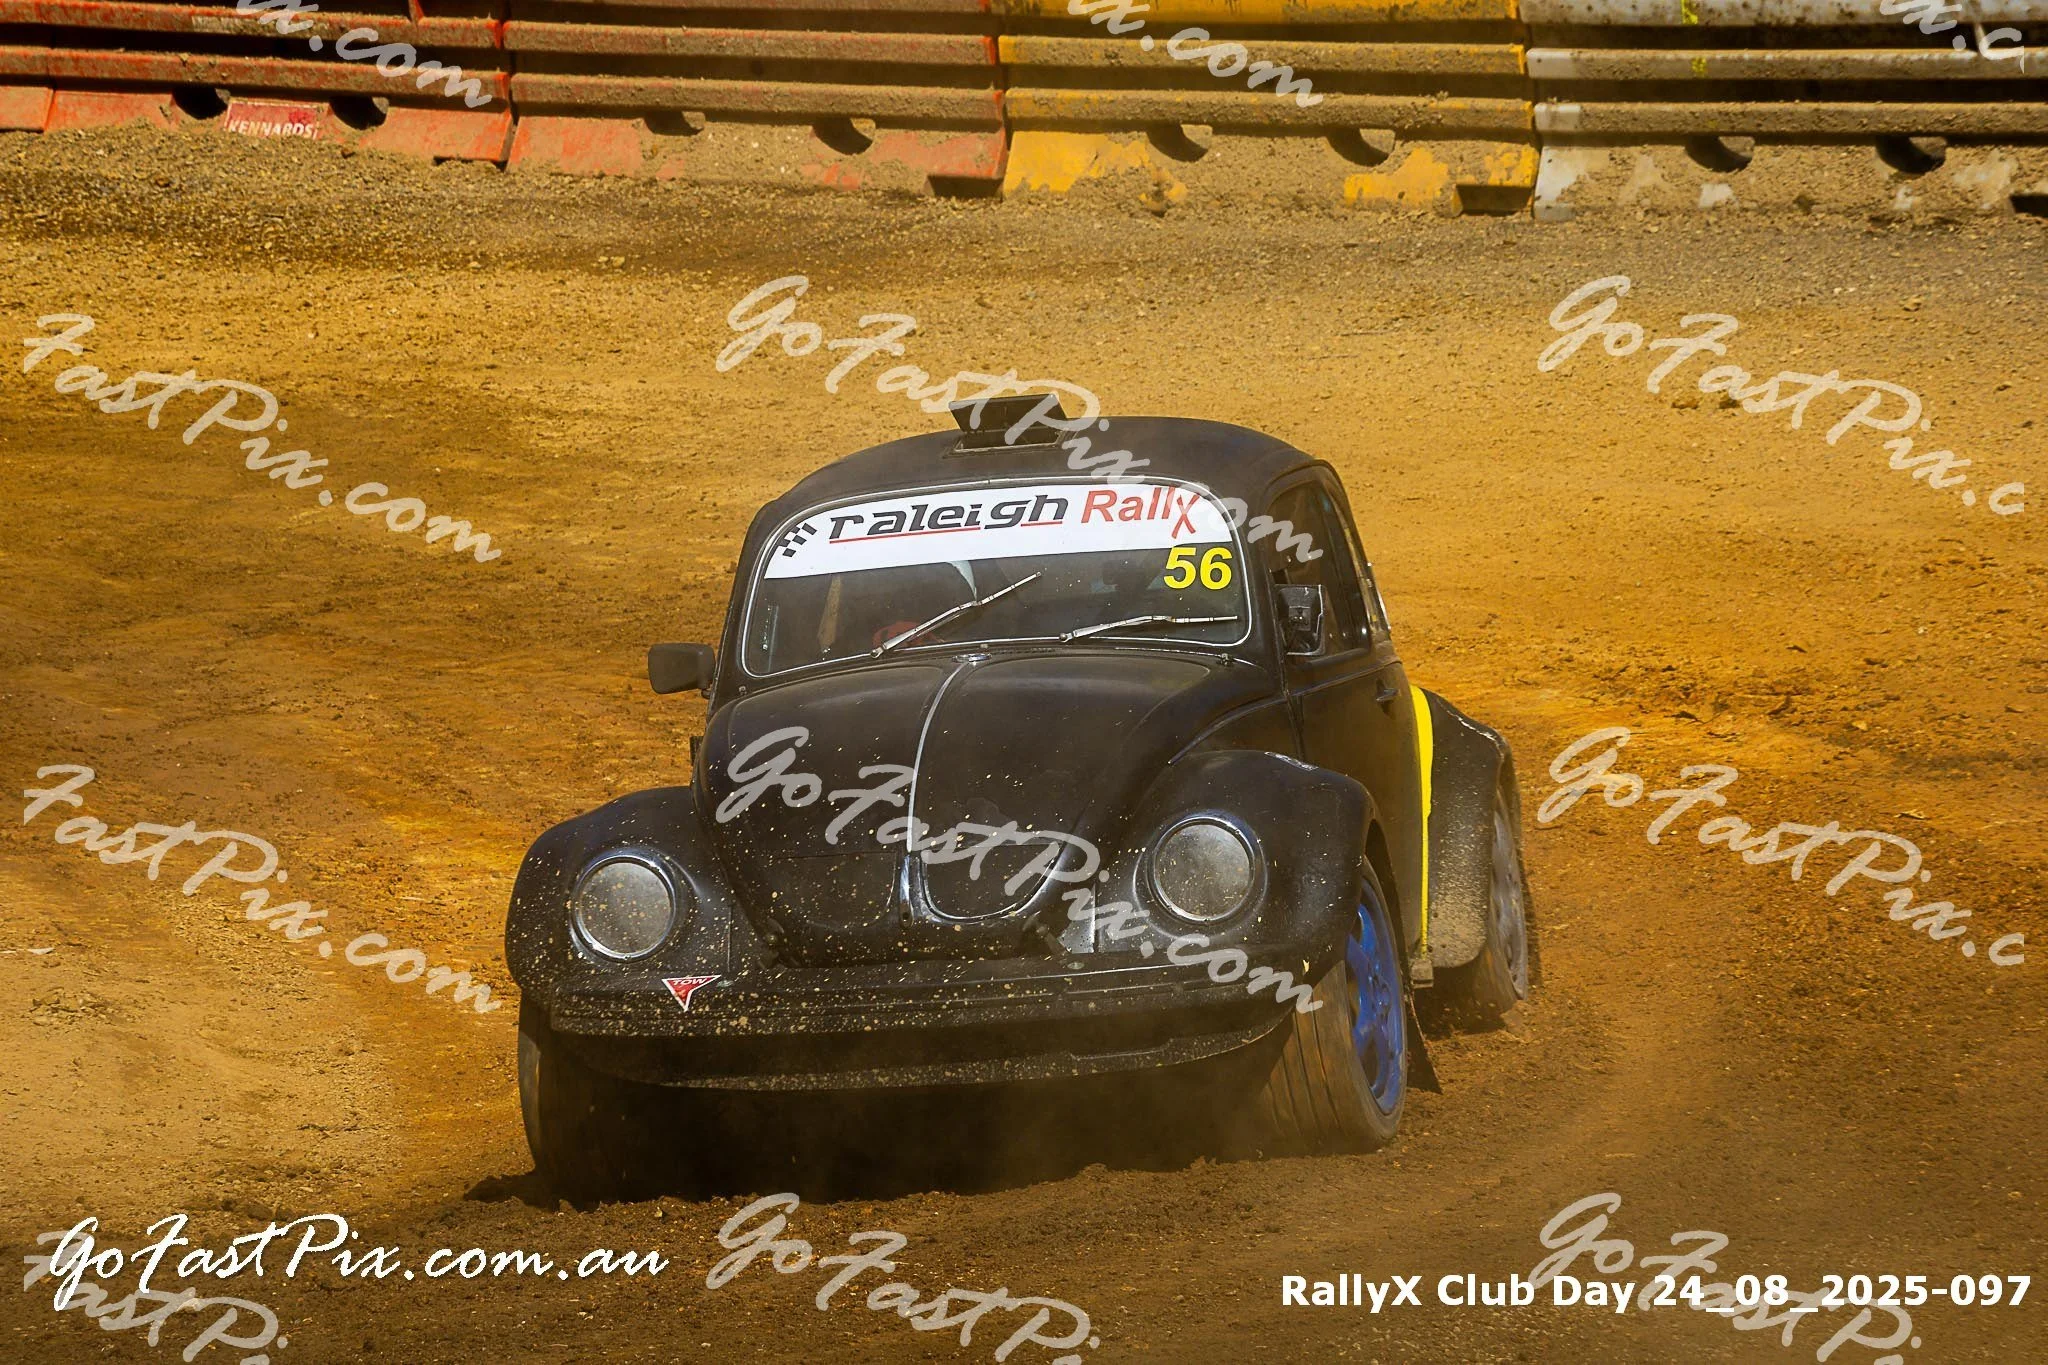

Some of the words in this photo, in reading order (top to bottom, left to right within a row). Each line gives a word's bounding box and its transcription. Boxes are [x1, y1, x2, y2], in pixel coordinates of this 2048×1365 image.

[228, 119, 314, 138] KENNARDS
[829, 494, 1069, 538] raleigh
[1163, 546, 1234, 590] 56
[672, 978, 707, 986] TOW
